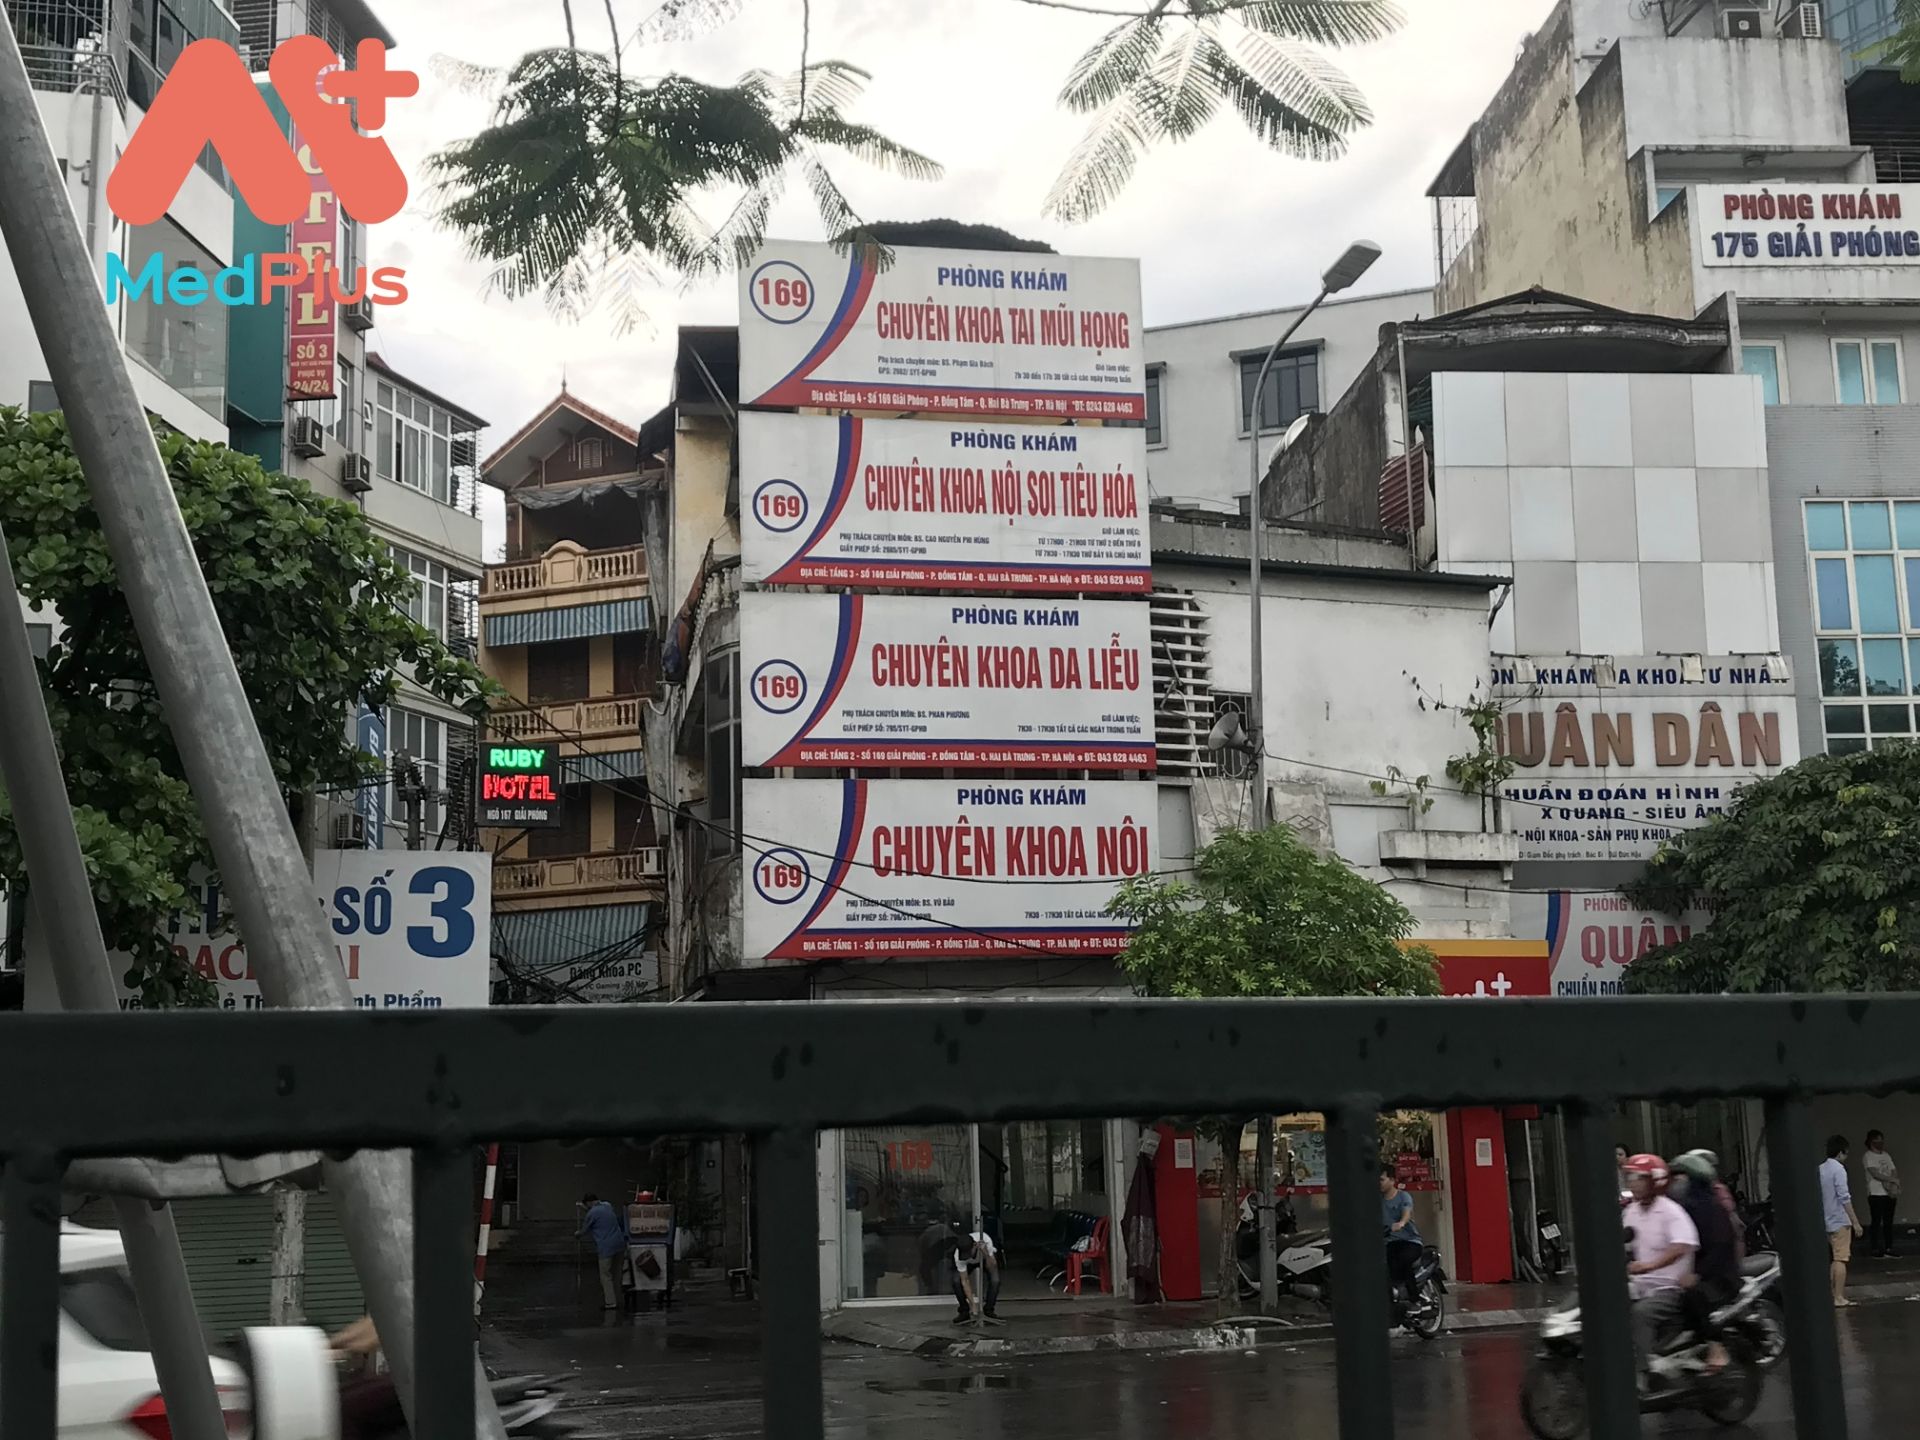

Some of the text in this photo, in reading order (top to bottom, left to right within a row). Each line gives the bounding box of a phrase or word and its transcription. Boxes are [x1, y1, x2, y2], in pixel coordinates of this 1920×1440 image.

[1724, 188, 1901, 220] PHÒNG KHÁM
[1711, 222, 1920, 258] 175 GIẢI PHÓNG
[938, 264, 1067, 291] PHÒNG KHÁM
[758, 278, 808, 307] 169
[877, 296, 1130, 356] CHUYÊN KHOA TAI MŨI HỌNG
[296, 339, 327, 359] SỐ 3
[293, 379, 329, 393] 24/24
[950, 428, 1077, 452] PHÒNG KHÁM
[865, 456, 1137, 526] CHUYÊN KHOA NỘI SOI TIÊU HÓA
[760, 494, 800, 518] 169
[1109, 576, 1124, 585] 628
[952, 605, 1079, 627] PHÒNG KHÁM
[872, 632, 1140, 691] CHUYÊN KHOA DA LIỄU
[758, 675, 799, 699] 169
[1637, 668, 1684, 684] KHO
[1496, 701, 1781, 767] UÂN DÂN
[490, 748, 545, 768] RUBY
[850, 752, 855, 760] 2
[861, 749, 871, 760] SỐ
[872, 752, 885, 760] 169
[1112, 754, 1127, 762] 628
[1128, 754, 1147, 763] 4463
[483, 774, 556, 800] HOTEL
[957, 785, 1086, 806] PHÒNG KHÁM
[1577, 783, 1647, 801] ĐOÁN
[1656, 783, 1720, 800] HÌNH
[1541, 803, 1722, 821] X QUANG SIÊU ÂM
[873, 815, 996, 877] CHUYÊN
[1006, 826, 1087, 876] KHOA
[1525, 827, 1546, 847] NỘI
[1549, 829, 1579, 842] KHOA
[1616, 829, 1639, 844] PHỤ
[1642, 828, 1671, 841] KHOA
[761, 865, 801, 888] 169
[331, 866, 475, 958] SỐ 3
[1584, 894, 1627, 911] PHÒNG
[1581, 917, 1691, 968] QUÂN
[599, 964, 625, 978] Khoa
[628, 962, 642, 976] PC
